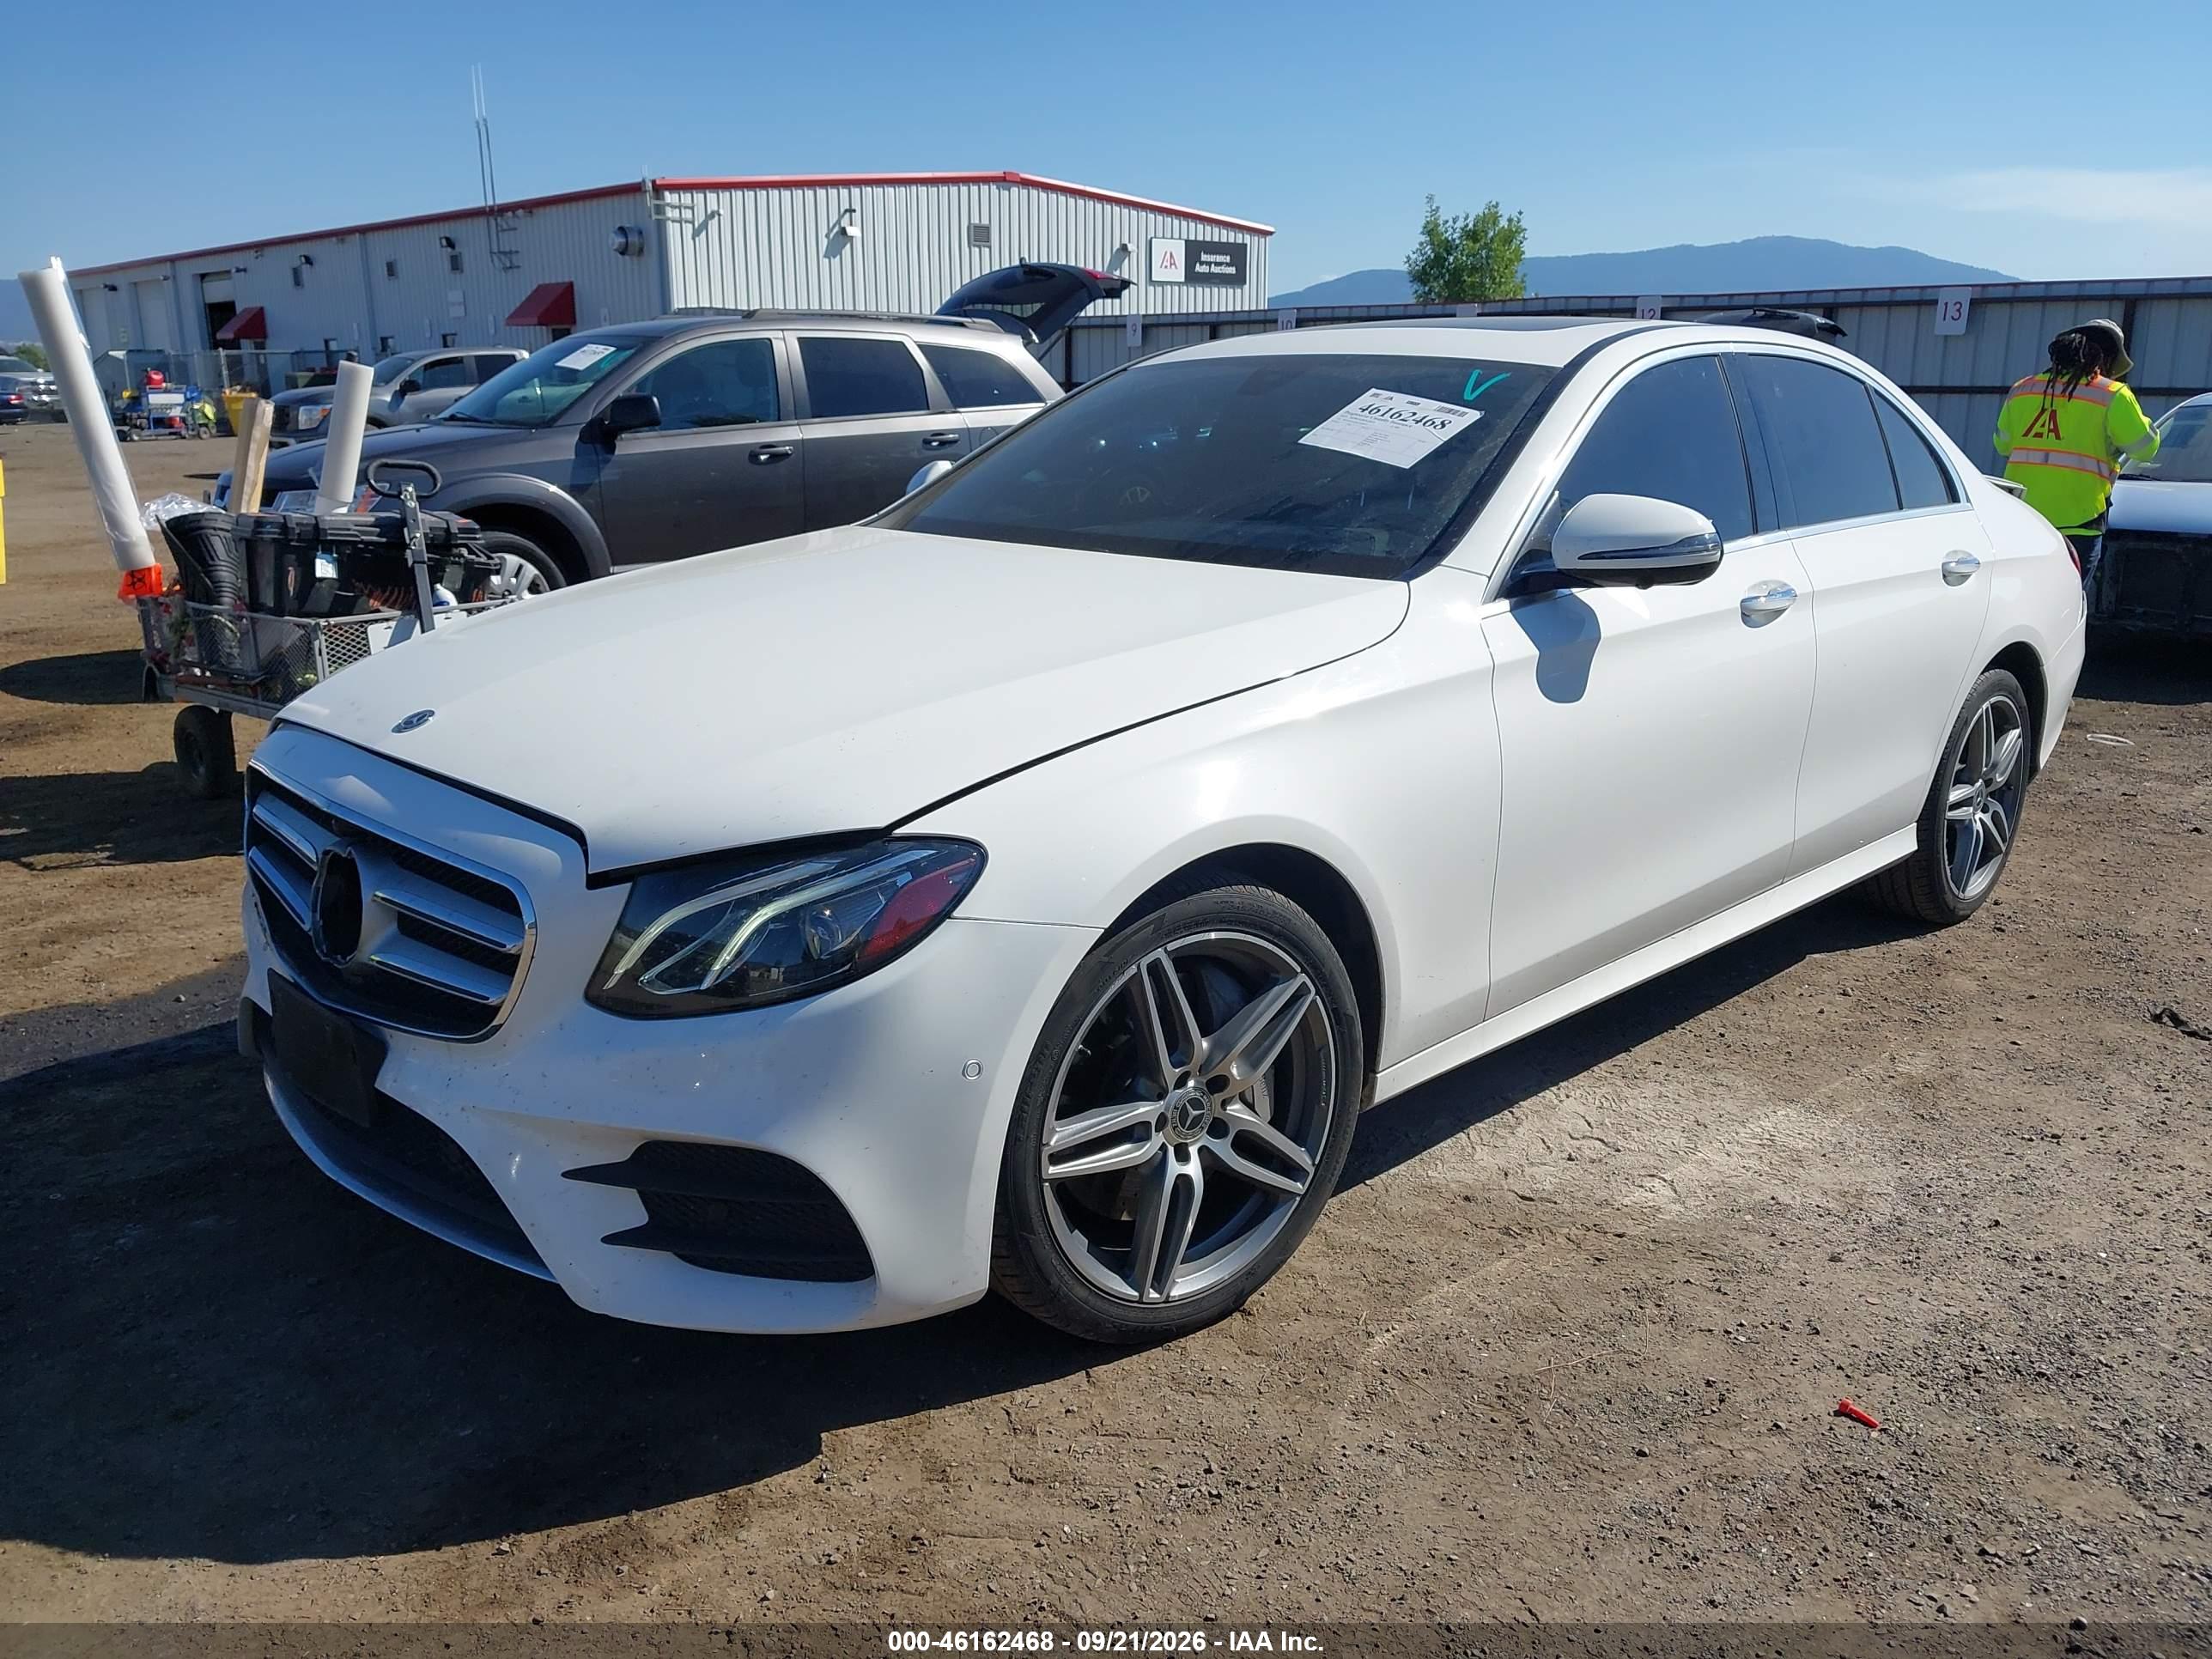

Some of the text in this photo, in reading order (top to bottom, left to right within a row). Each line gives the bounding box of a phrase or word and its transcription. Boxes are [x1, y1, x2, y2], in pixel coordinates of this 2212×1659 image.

[1200, 251, 1231, 263] Insurance
[1194, 262, 1237, 274] Auto Auctions
[1641, 308, 1656, 319] 12
[1942, 301, 1963, 322] 13
[1131, 322, 1138, 337] 9
[1358, 403, 1452, 430] 46162468
